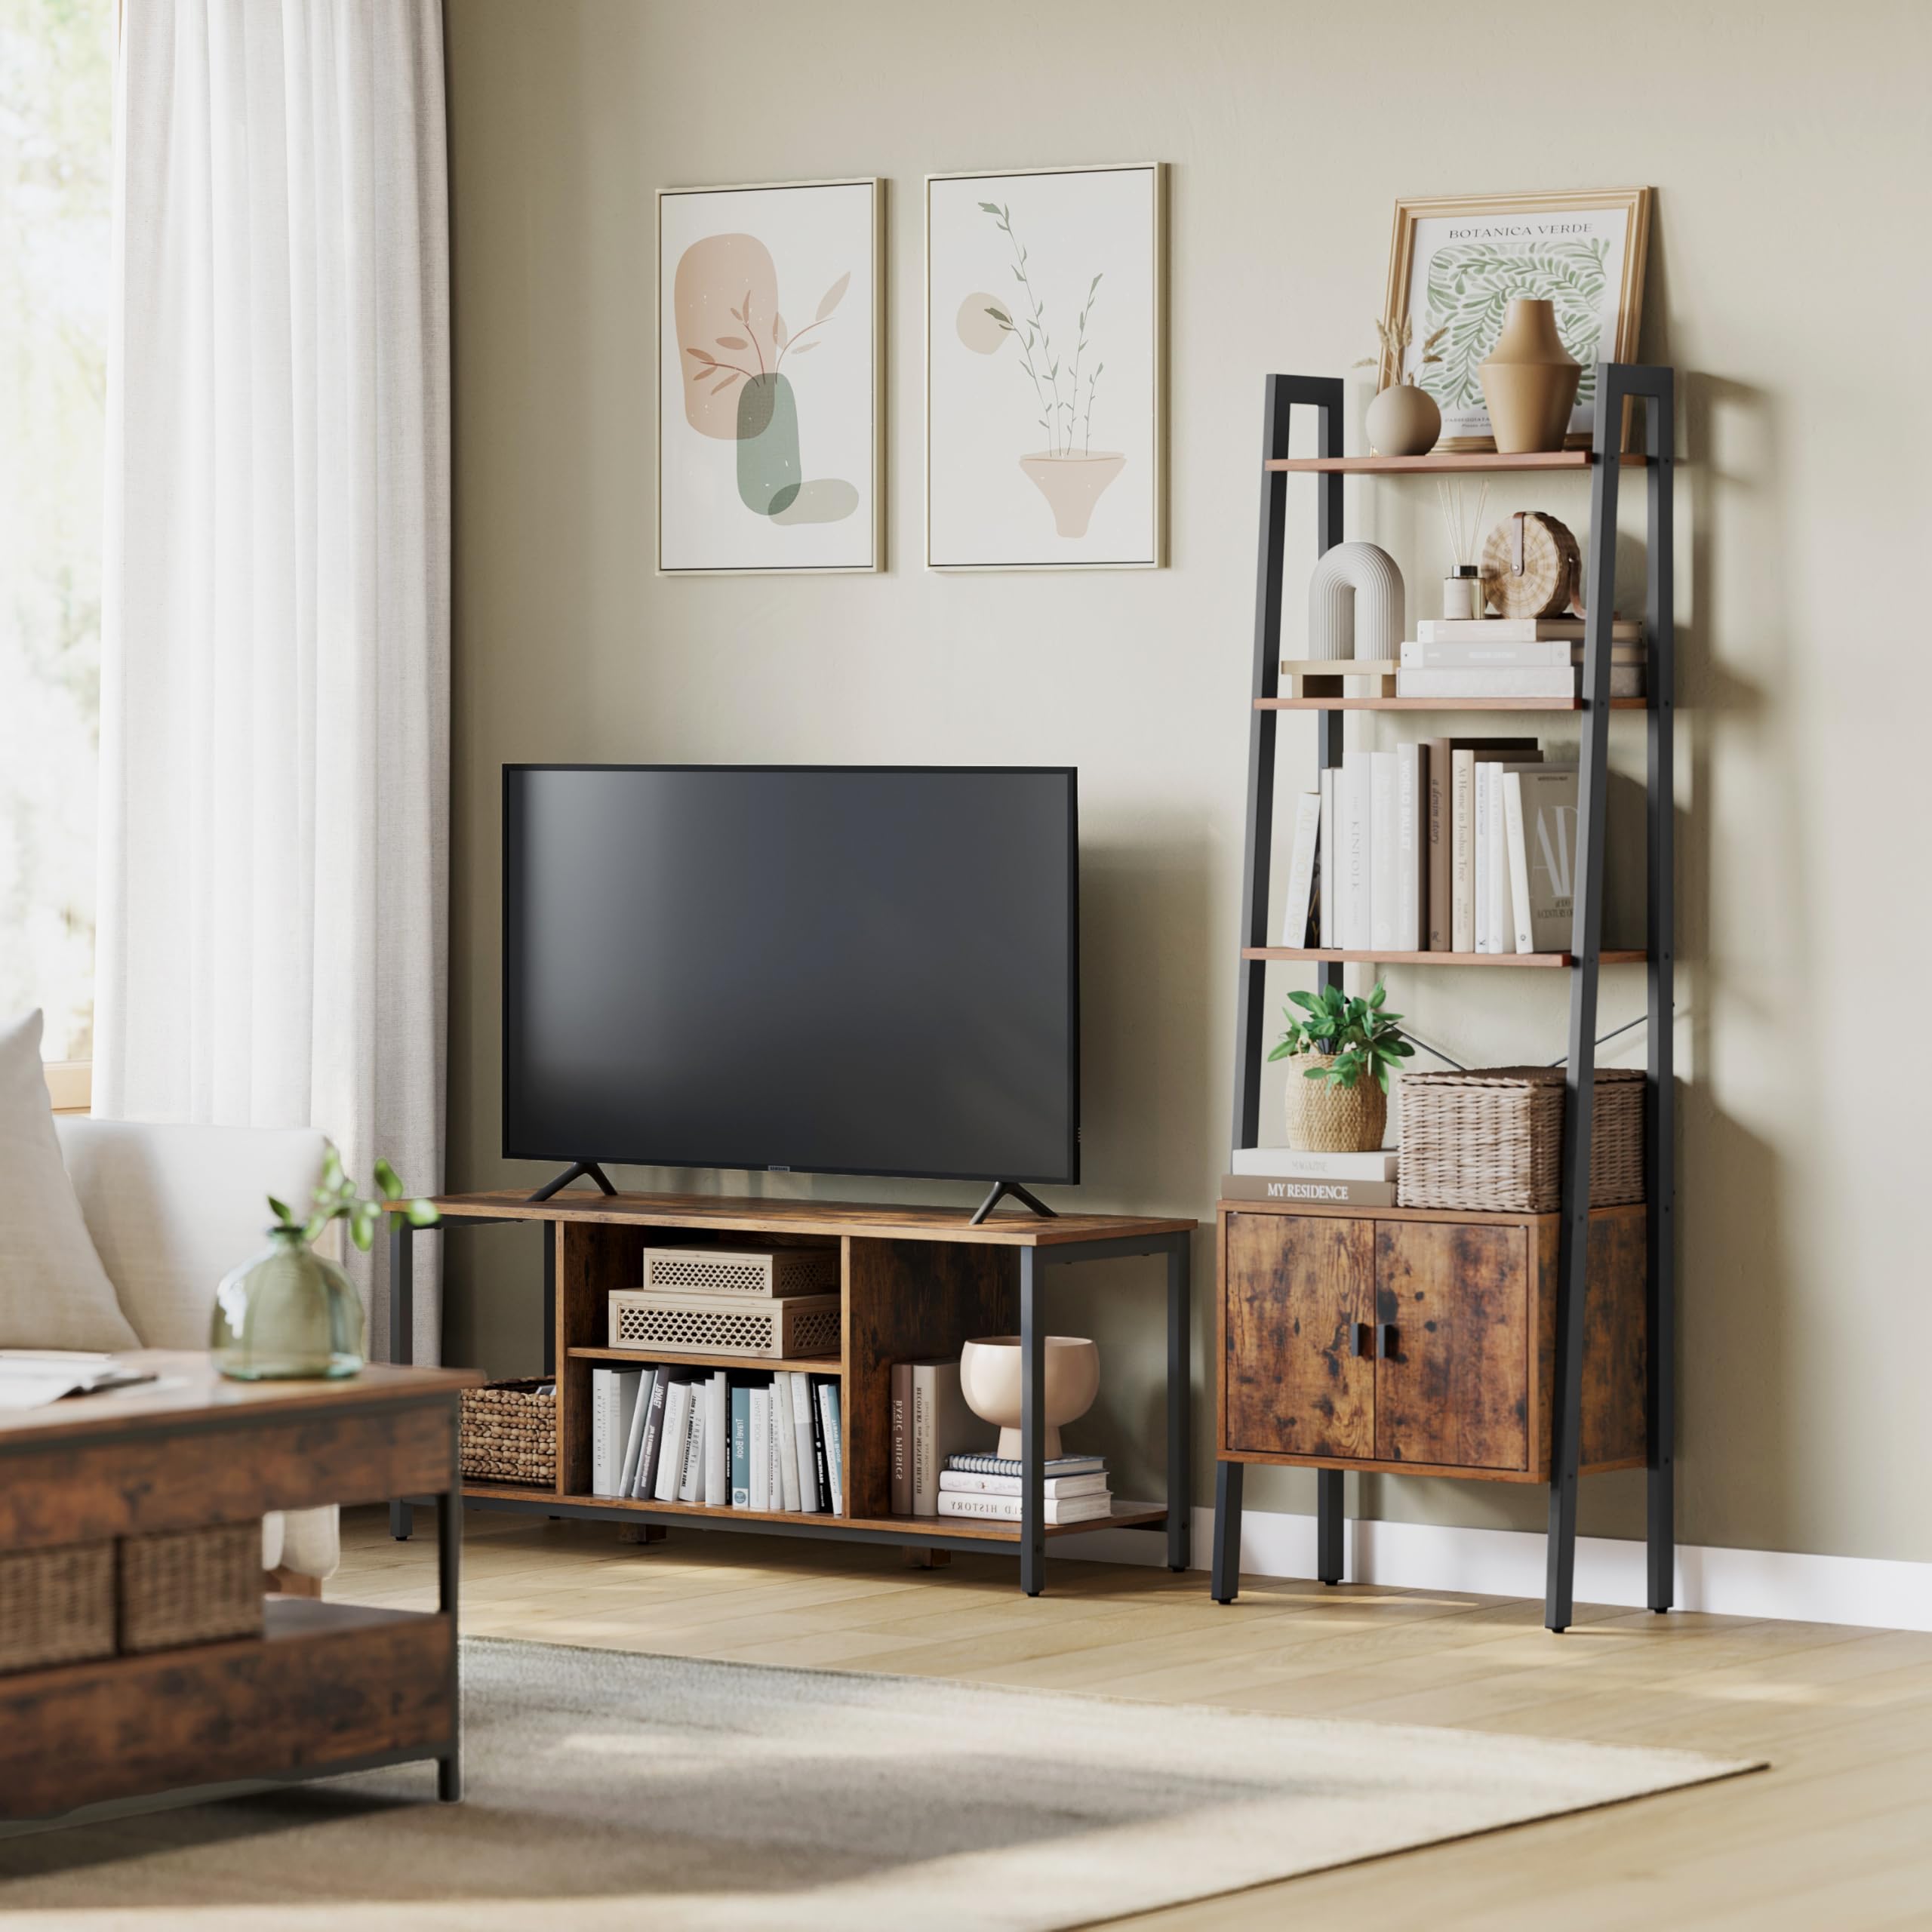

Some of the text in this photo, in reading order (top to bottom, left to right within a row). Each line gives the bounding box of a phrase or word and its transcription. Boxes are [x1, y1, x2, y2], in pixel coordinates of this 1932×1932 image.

[1449, 223, 1594, 239] BOTANICA VERDE
[1401, 759, 1411, 804] WORLD
[1432, 787, 1442, 817] denim
[1429, 820, 1441, 844] story
[1457, 765, 1468, 882] At Home in Joshua Tree
[1351, 821, 1360, 893] KINFOLK
[1267, 1183, 1349, 1200] MY RESIDENCE
